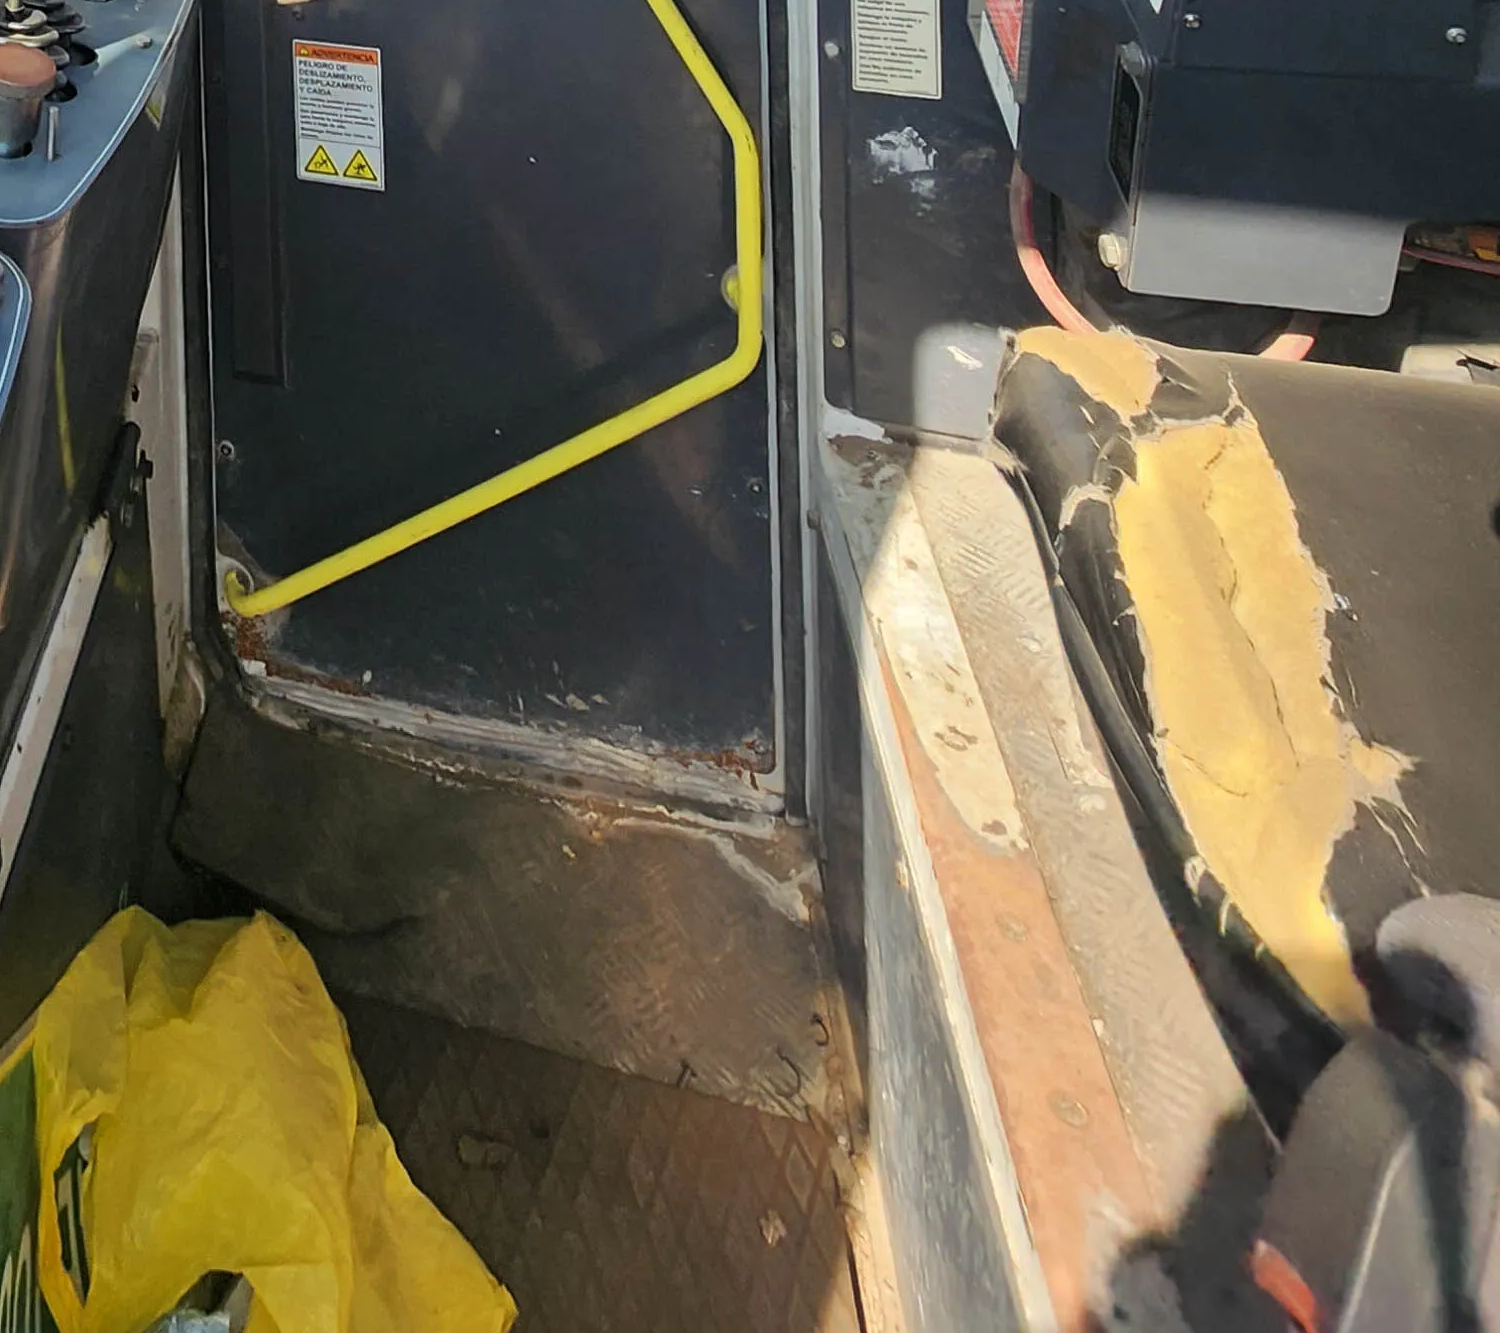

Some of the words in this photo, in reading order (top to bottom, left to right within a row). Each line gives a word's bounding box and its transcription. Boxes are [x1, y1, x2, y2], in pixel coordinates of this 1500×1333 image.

[312, 48, 375, 63] ADVERTENCIA
[298, 60, 334, 70] PELIGRO
[299, 77, 373, 92] DESPLAZAMIENTO
